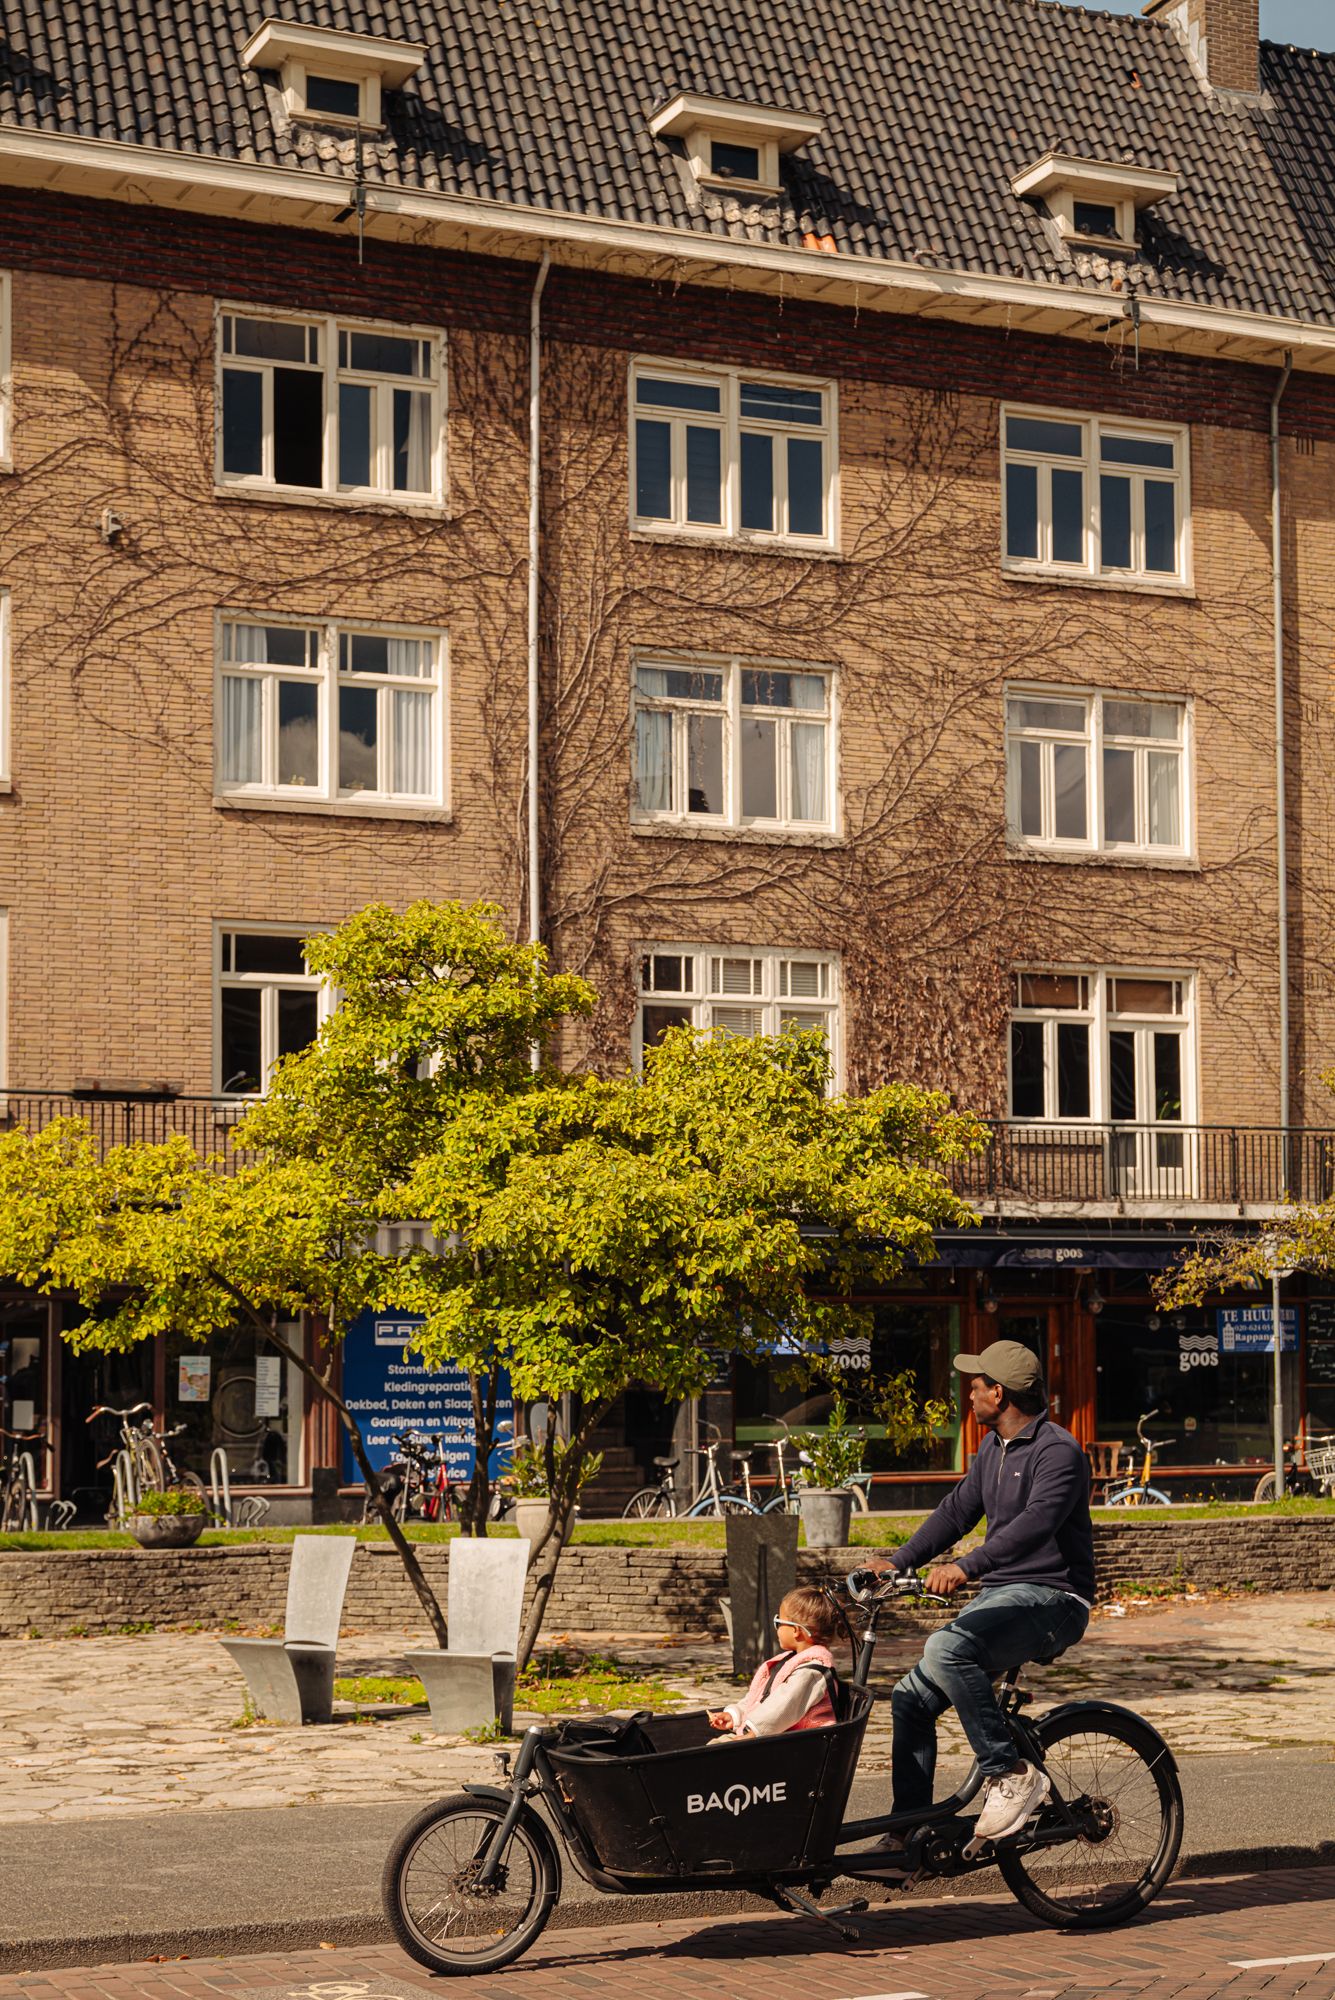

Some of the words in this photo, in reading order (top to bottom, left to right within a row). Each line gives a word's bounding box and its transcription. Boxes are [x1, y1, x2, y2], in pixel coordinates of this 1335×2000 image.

[1056, 1248, 1083, 1262] goos
[1222, 1309, 1238, 1322] TE
[1179, 1352, 1219, 1372] goos
[345, 1399, 389, 1411] Dekbed,
[391, 1399, 426, 1410] Deken
[427, 1400, 442, 1409] en
[371, 1416, 424, 1430] Gordijnen
[426, 1417, 440, 1426] en
[367, 1434, 390, 1445] Leer
